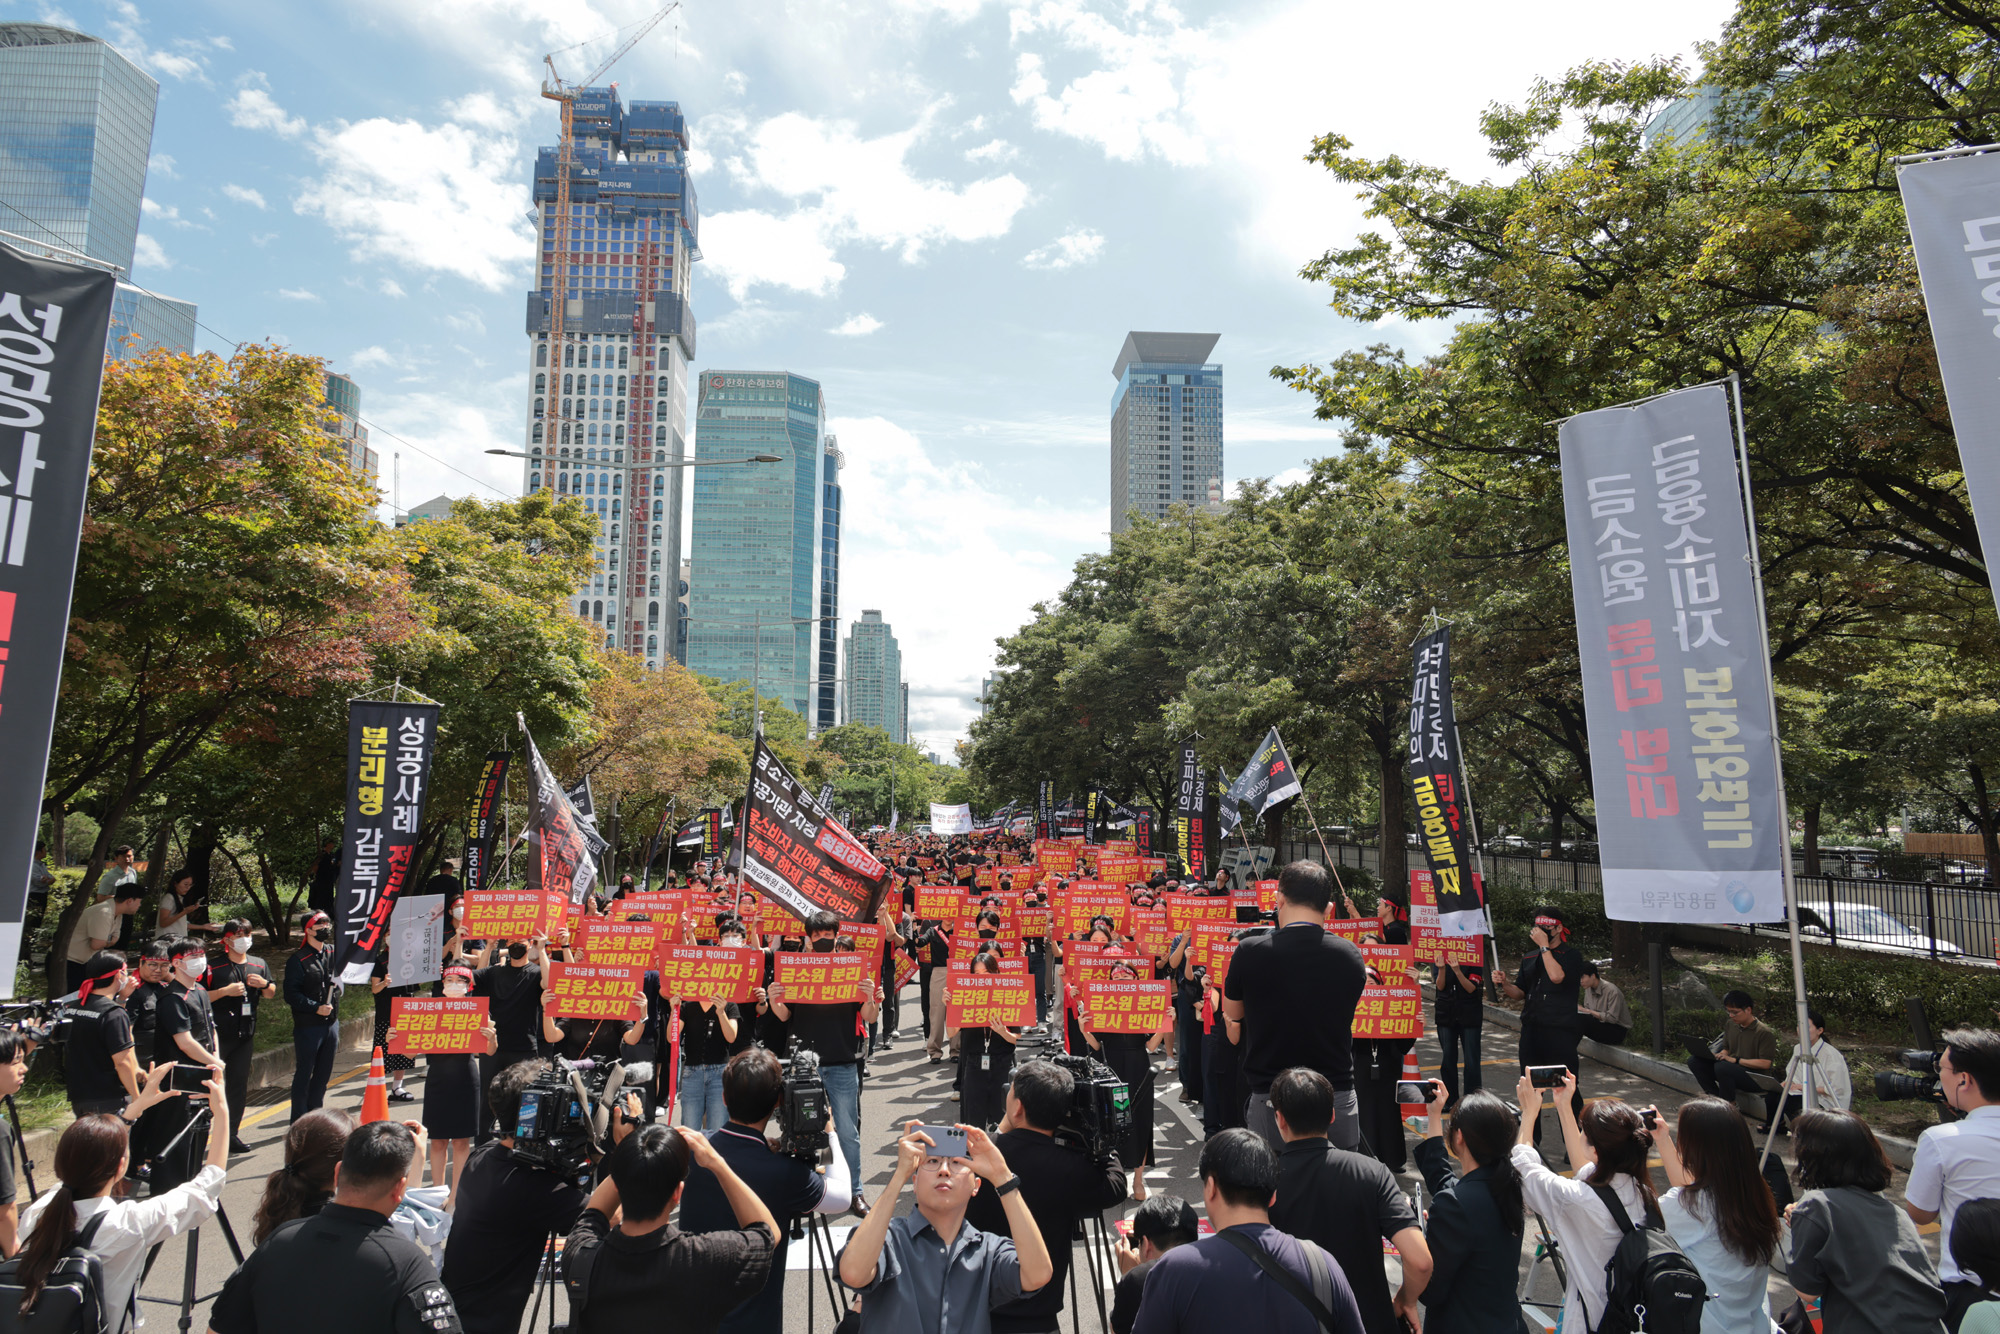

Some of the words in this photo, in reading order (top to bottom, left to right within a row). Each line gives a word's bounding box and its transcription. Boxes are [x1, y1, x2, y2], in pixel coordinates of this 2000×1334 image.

[358, 726, 388, 815] 분리형
[393, 717, 425, 833] 성공사례
[1179, 750, 1194, 811] 모피아의
[1086, 822, 1094, 845] 감독기
[1413, 776, 1460, 895] 금융독재
[790, 811, 818, 838] 지정
[821, 833, 881, 876] 철회하라!
[749, 808, 794, 852] 융소비자
[791, 844, 821, 872] 피해
[818, 865, 868, 901] 초래하는
[1101, 866, 1122, 874] 금소원
[1124, 865, 1139, 873] 분리
[344, 828, 383, 943] 감독기구
[745, 861, 779, 888] 금융감독원
[794, 895, 808, 912] 12기
[778, 855, 803, 885] 해체
[802, 876, 859, 919] 중단하라!
[919, 896, 945, 906] 금소원
[1171, 898, 1207, 906] 금융소비자보호
[469, 905, 509, 919] 금소원
[512, 905, 540, 919] 분리
[1070, 906, 1101, 917] 금소원
[1105, 906, 1125, 917] 분리
[1171, 906, 1203, 918] 금소원
[1207, 907, 1226, 918] 분리
[472, 922, 535, 936] 반대한다!
[694, 928, 719, 937] 한다!
[763, 921, 786, 932] 결사
[1323, 921, 1356, 930] 융소비자보호
[1421, 929, 1434, 937] 실익
[586, 936, 626, 950] 금소원
[629, 936, 655, 950] 분리
[855, 937, 878, 949] 분리
[1418, 938, 1476, 952] 금융소비자는
[673, 949, 703, 958] 관치금융
[706, 950, 736, 960] 막아내고
[1372, 948, 1399, 956] 막아내고
[589, 953, 650, 966] 반대한다!
[781, 956, 830, 964] 금융소비자보호
[833, 956, 861, 964] 역행하는
[1364, 959, 1407, 973] 소비자
[565, 967, 595, 976] 관치금융
[599, 968, 629, 977] 막아내고
[665, 961, 743, 980] 금융소비자
[781, 968, 826, 983] 금소원
[831, 967, 861, 982] 분리
[554, 979, 636, 997] 금융소비자
[670, 980, 736, 998] 보호하자!
[956, 978, 992, 986] 국제기준에
[995, 978, 1024, 986] 부합하는
[1090, 983, 1136, 992] 금융소비자보호
[1139, 984, 1166, 992] 역행하는
[784, 986, 815, 1000] 결사
[822, 984, 858, 1000] 반대!
[952, 990, 989, 1005] 금감원
[992, 989, 1029, 1005] 독립성
[1390, 989, 1416, 997] 역행하는
[403, 1002, 442, 1010] 국제기준에
[446, 1001, 477, 1010] 부합하는
[558, 998, 630, 1016] 보호하자!
[1089, 995, 1133, 1011] 금소원
[1137, 995, 1166, 1011] 분리
[1355, 1001, 1383, 1015] 소원
[1389, 1000, 1415, 1016] 분리
[396, 1014, 438, 1030] 금감원
[441, 1014, 482, 1030] 독립성
[962, 1007, 1020, 1023] 보장하라!
[1093, 1014, 1123, 1029] 결사
[1129, 1013, 1163, 1030] 반대!
[1380, 1019, 1413, 1034] 반대!
[406, 1033, 471, 1050] 보장하라!
